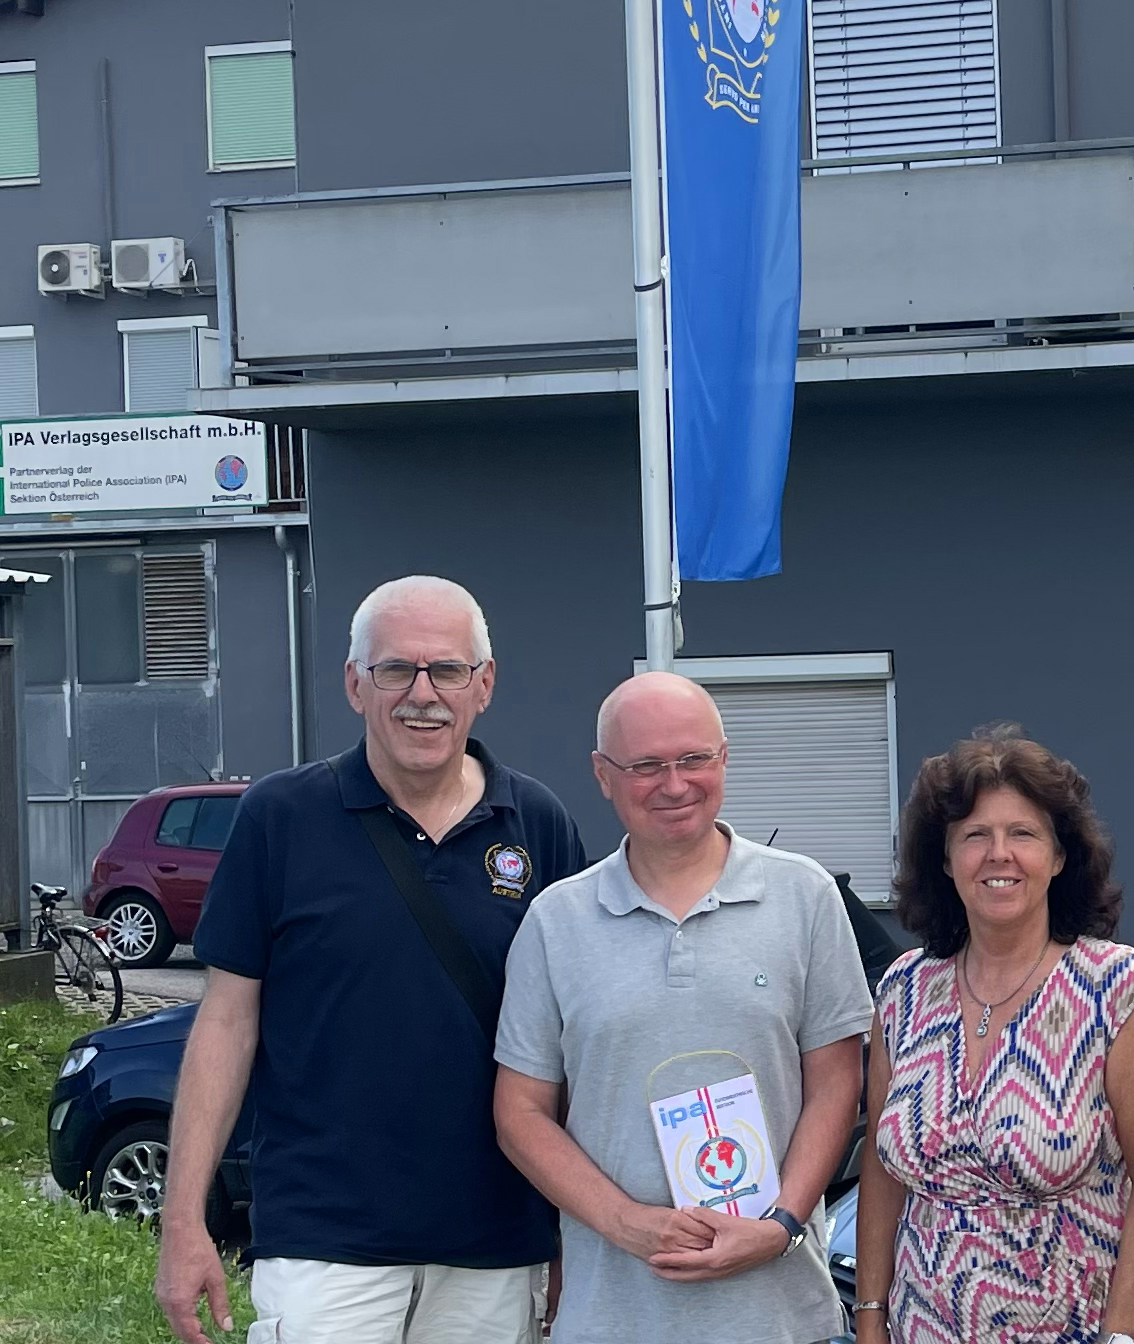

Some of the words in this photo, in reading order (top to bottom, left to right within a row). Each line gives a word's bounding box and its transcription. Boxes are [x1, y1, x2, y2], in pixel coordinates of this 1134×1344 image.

[9, 432, 35, 447] IPA
[40, 424, 201, 446] Verlagsgesellschaft
[207, 422, 262, 438] m.b.H.
[9, 466, 74, 477] Partnerverlag
[77, 465, 93, 474] der
[10, 479, 70, 490] International
[73, 478, 102, 488] Police
[105, 475, 163, 487] Association
[165, 474, 188, 486] (IPA)
[10, 494, 47, 504] Sektion
[50, 491, 100, 502] Österreich
[658, 1100, 707, 1129] ipa
